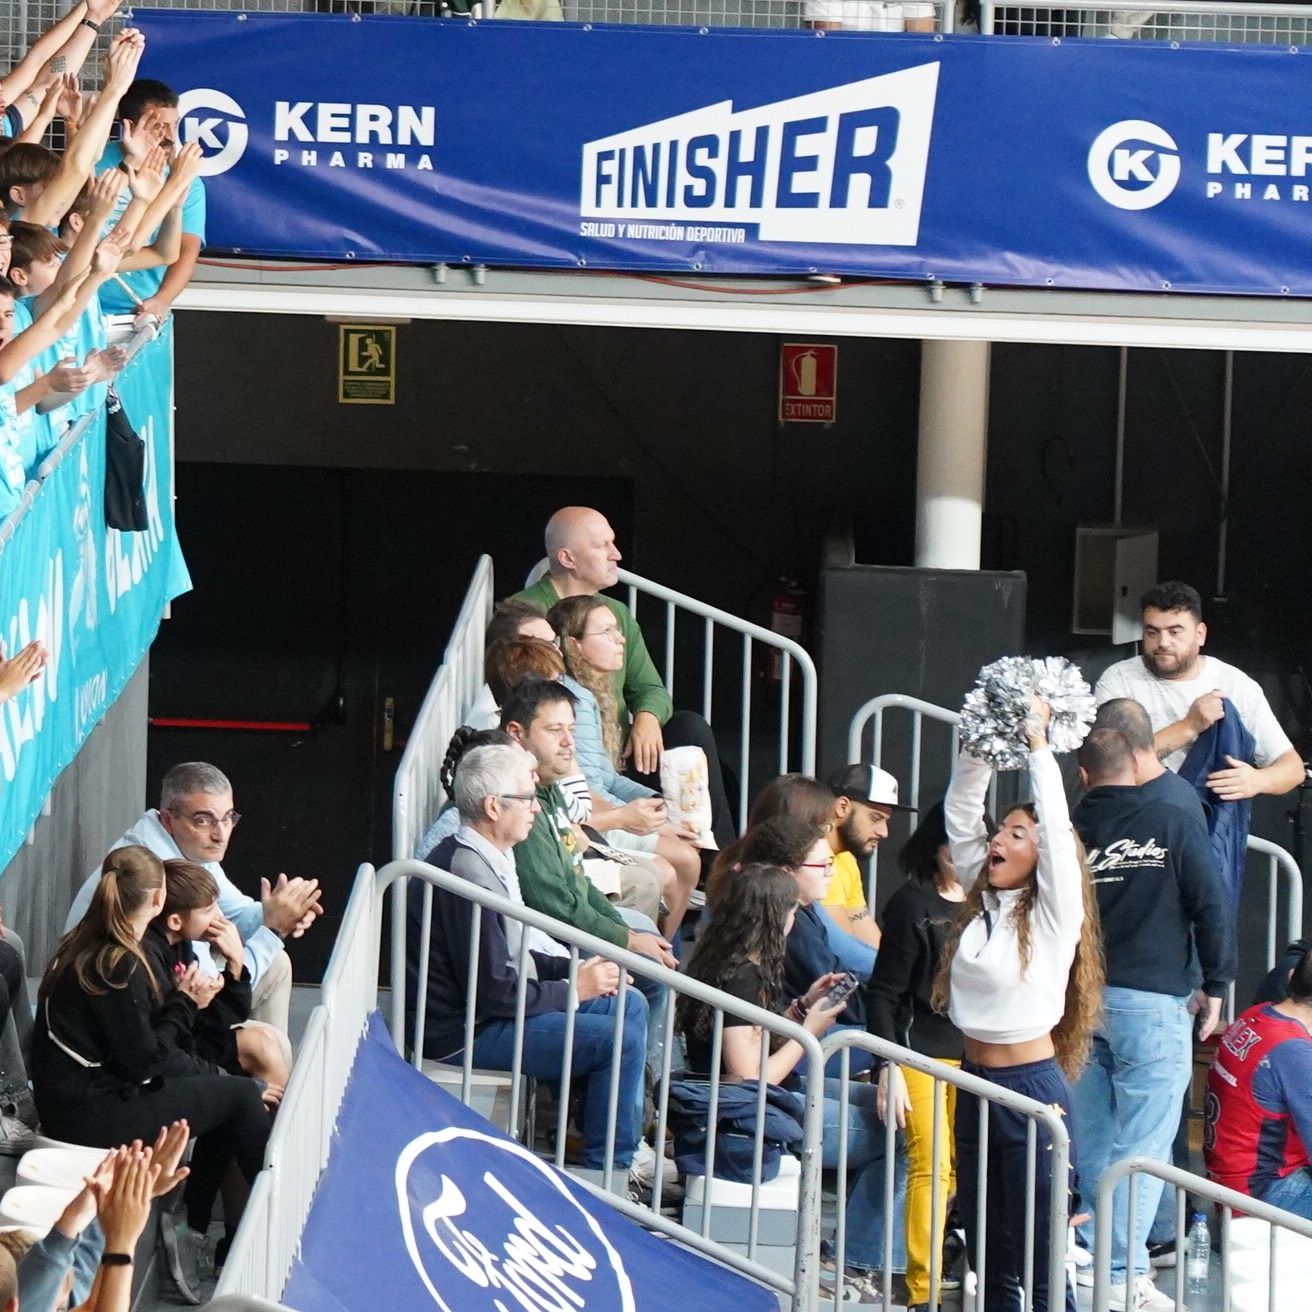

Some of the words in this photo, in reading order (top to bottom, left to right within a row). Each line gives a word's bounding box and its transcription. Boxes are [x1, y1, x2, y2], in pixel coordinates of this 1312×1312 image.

[274, 100, 436, 146] KERN
[274, 149, 433, 170] PHARMA
[595, 104, 901, 210] FINISHER
[580, 222, 616, 238] SALUD
[617, 224, 626, 238] Y
[627, 223, 685, 241] NUTRICIÓN
[687, 226, 746, 244] DEPORTIVA
[785, 402, 832, 417] EXTINTOR
